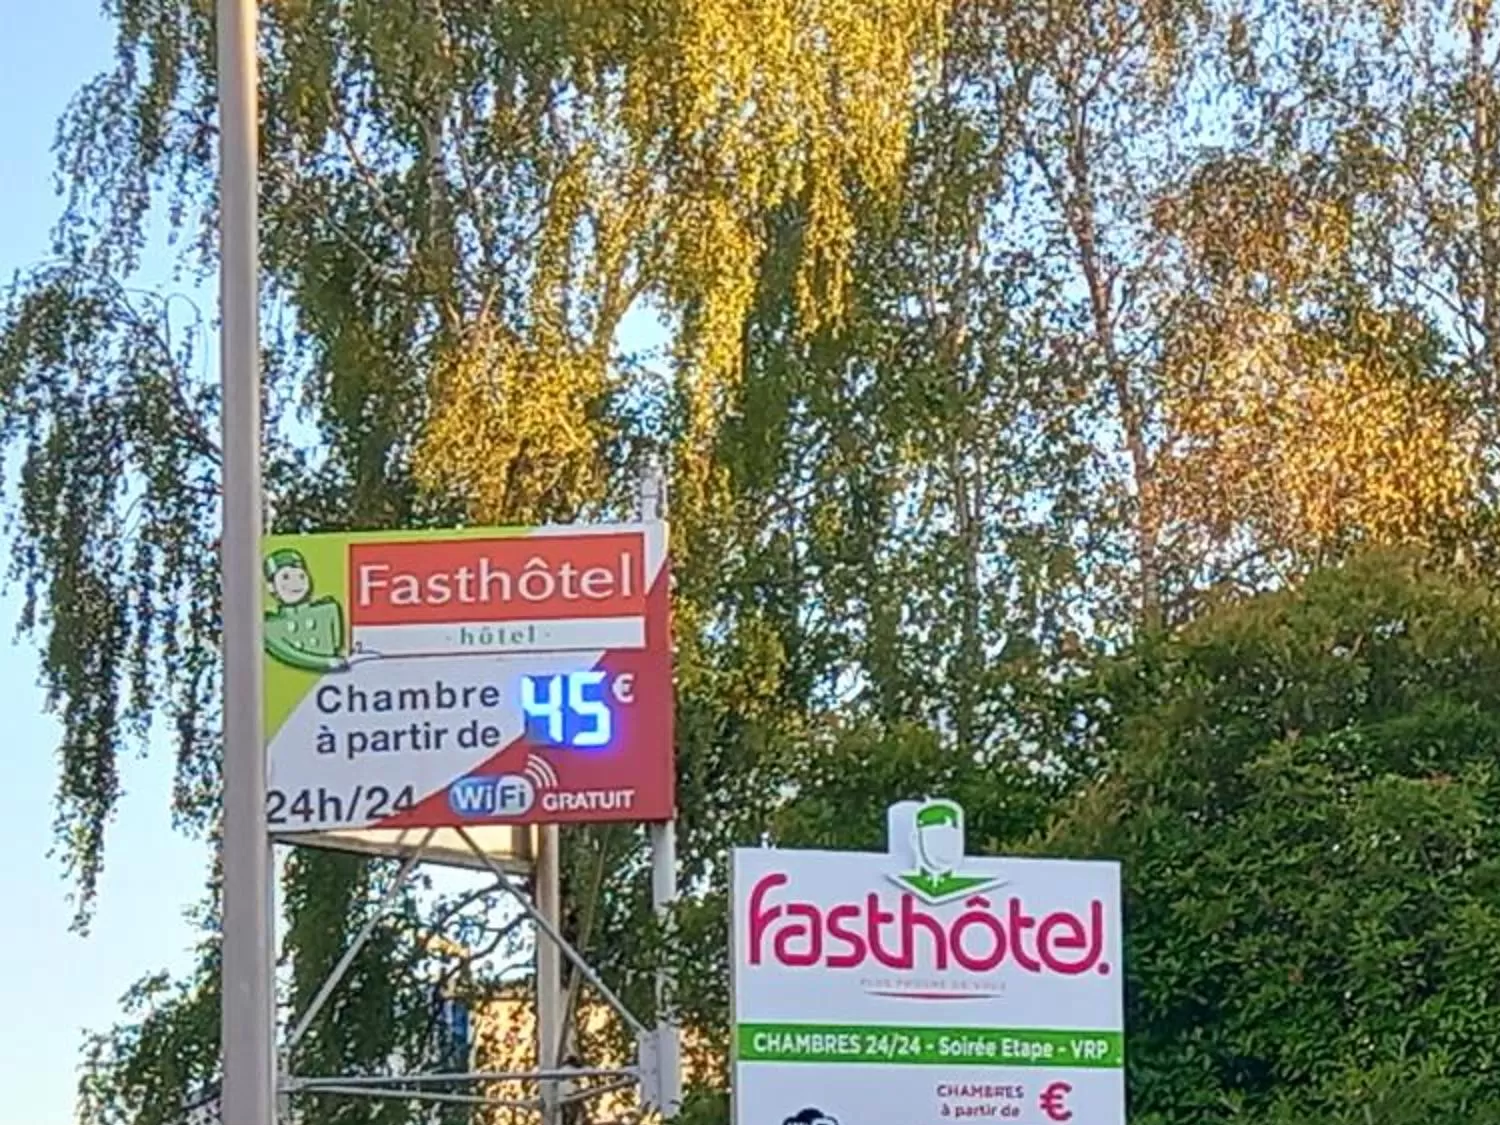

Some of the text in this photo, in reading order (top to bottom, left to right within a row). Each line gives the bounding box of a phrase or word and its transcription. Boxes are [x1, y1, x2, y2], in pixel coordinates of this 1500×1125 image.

[359, 553, 632, 607] Fasthôtel
[460, 625, 536, 646] hôtel
[316, 681, 500, 714] Chambre
[520, 671, 635, 747] 45 €
[316, 720, 500, 759] à partir de
[267, 785, 417, 824] 24h/24
[543, 790, 635, 811] GRATUIT
[753, 1032, 861, 1055] CHAMBRES
[865, 1034, 922, 1057] 24/24
[938, 1035, 996, 1057] Soirée
[1001, 1038, 1054, 1062] Etape
[1070, 1039, 1109, 1060] VRP
[936, 1084, 1024, 1100] CHAMBRES
[1040, 1081, 1073, 1121] €
[941, 1103, 1020, 1120] à partir de
